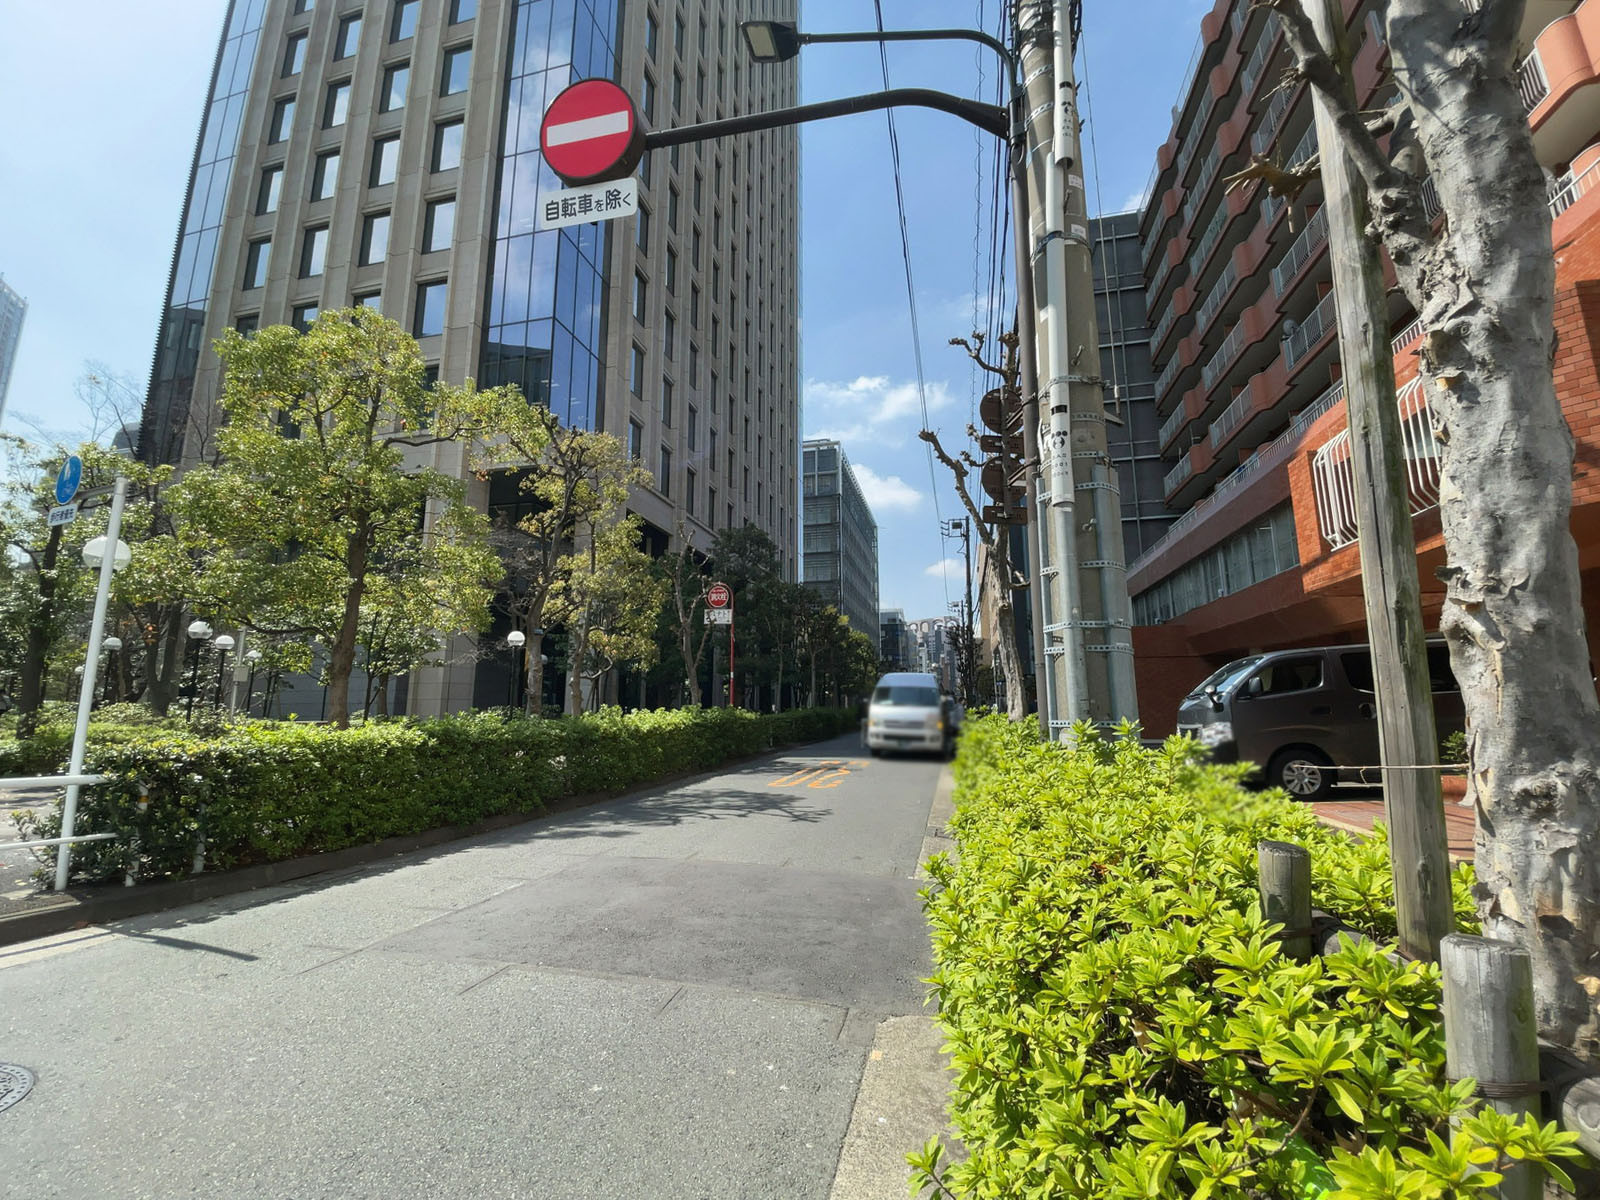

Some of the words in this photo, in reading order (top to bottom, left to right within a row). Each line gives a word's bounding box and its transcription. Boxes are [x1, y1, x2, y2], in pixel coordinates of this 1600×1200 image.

[545, 188, 632, 221] 自転車を除く
